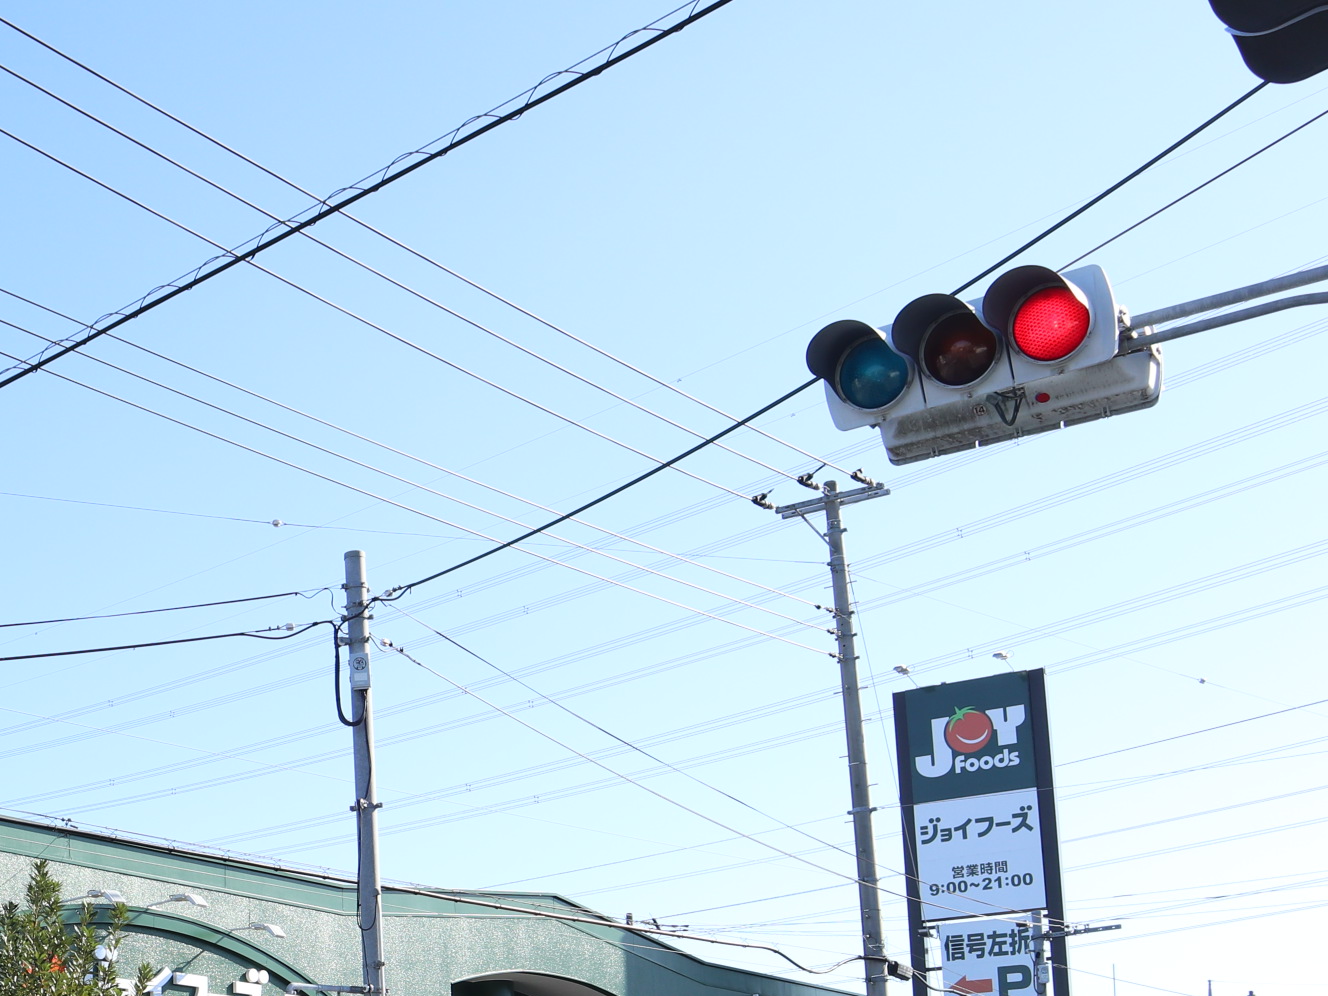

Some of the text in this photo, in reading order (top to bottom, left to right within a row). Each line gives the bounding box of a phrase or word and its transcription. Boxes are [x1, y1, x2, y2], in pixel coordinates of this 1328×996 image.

[920, 805, 1034, 845] ジョイフーズ
[952, 861, 1008, 879] 営業時間
[944, 928, 1030, 961] 信号左折
